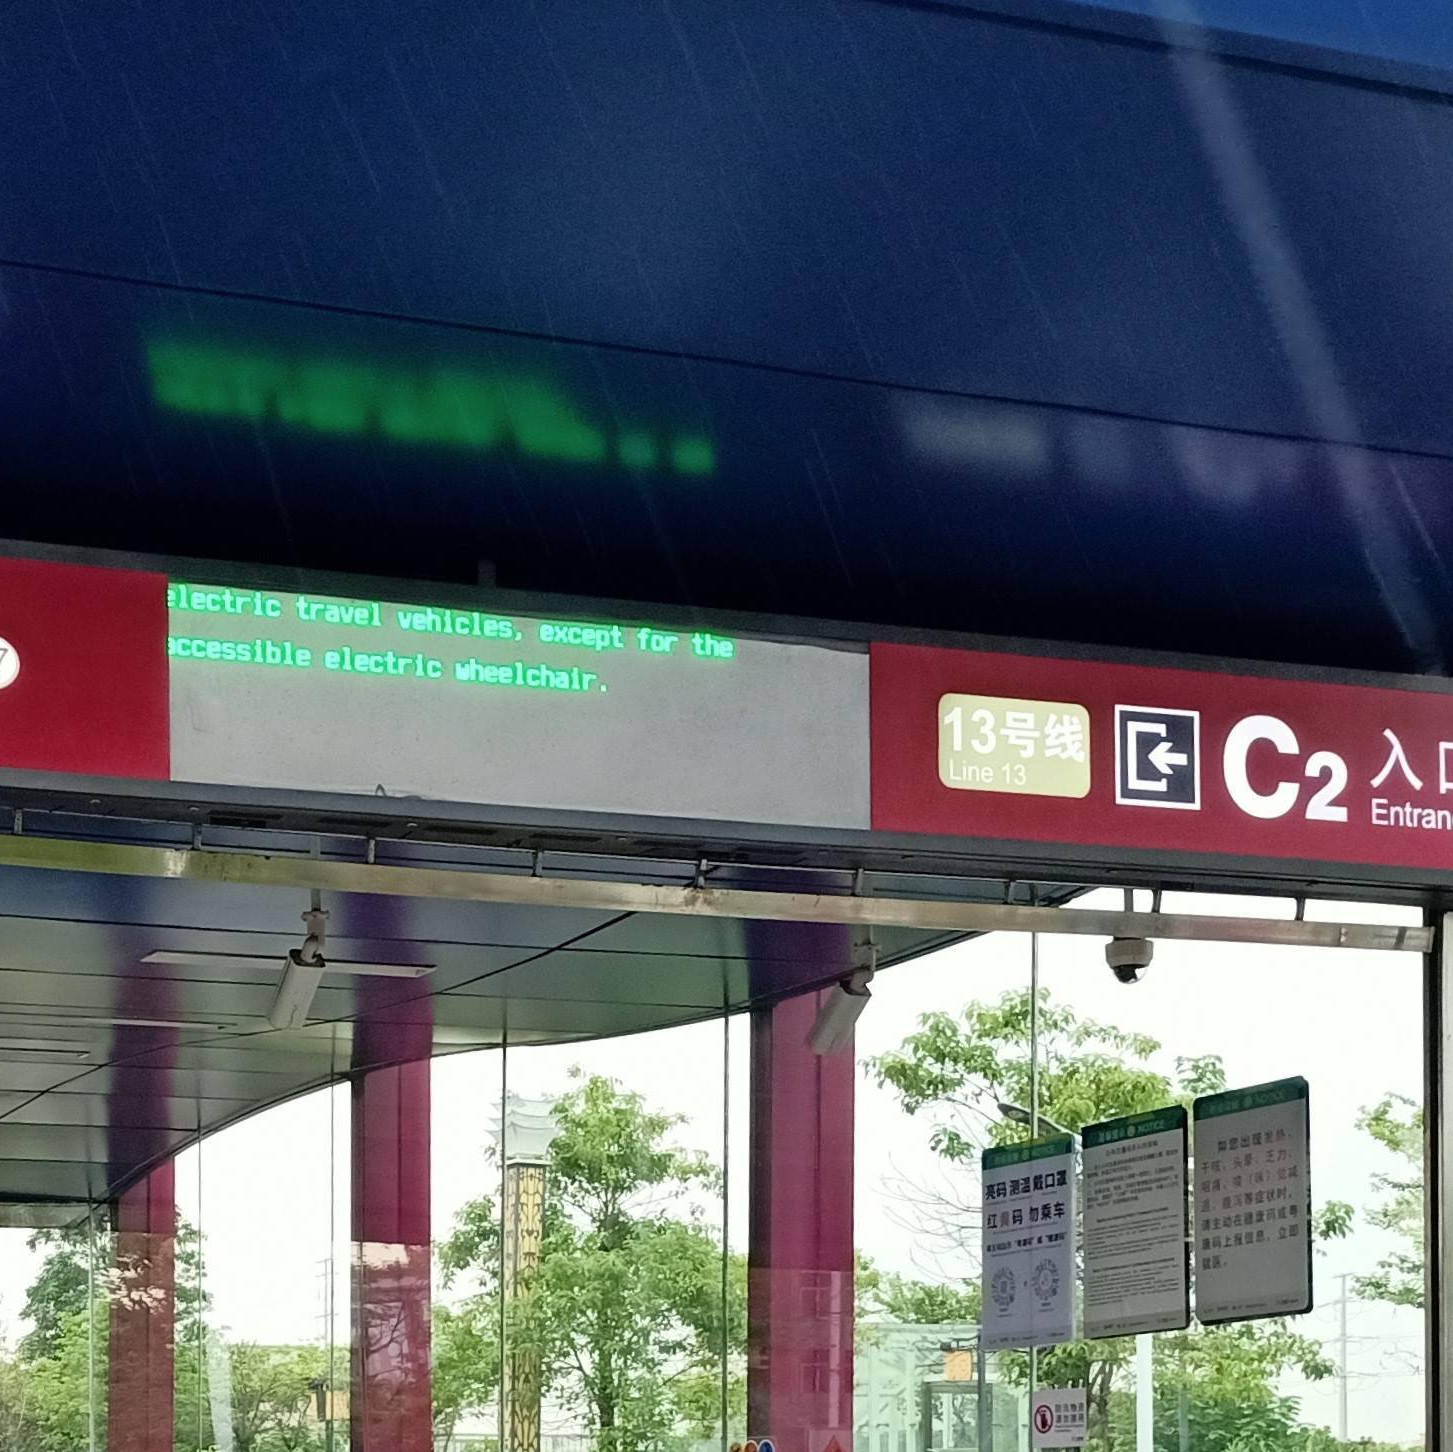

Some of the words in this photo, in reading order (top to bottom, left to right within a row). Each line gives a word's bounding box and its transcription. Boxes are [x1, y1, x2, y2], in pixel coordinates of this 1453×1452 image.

[295, 595, 382, 627] travel
[397, 607, 522, 641] vehicles,
[539, 622, 624, 651] except
[637, 628, 679, 652] for
[691, 632, 735, 658] the
[324, 647, 442, 679] electric
[454, 658, 607, 692] wheelchair.
[943, 706, 1086, 763] 13号线
[949, 759, 994, 783] Line
[1001, 762, 1027, 786] 13
[1222, 714, 1348, 823] C2
[1372, 798, 1453, 830] Entran
